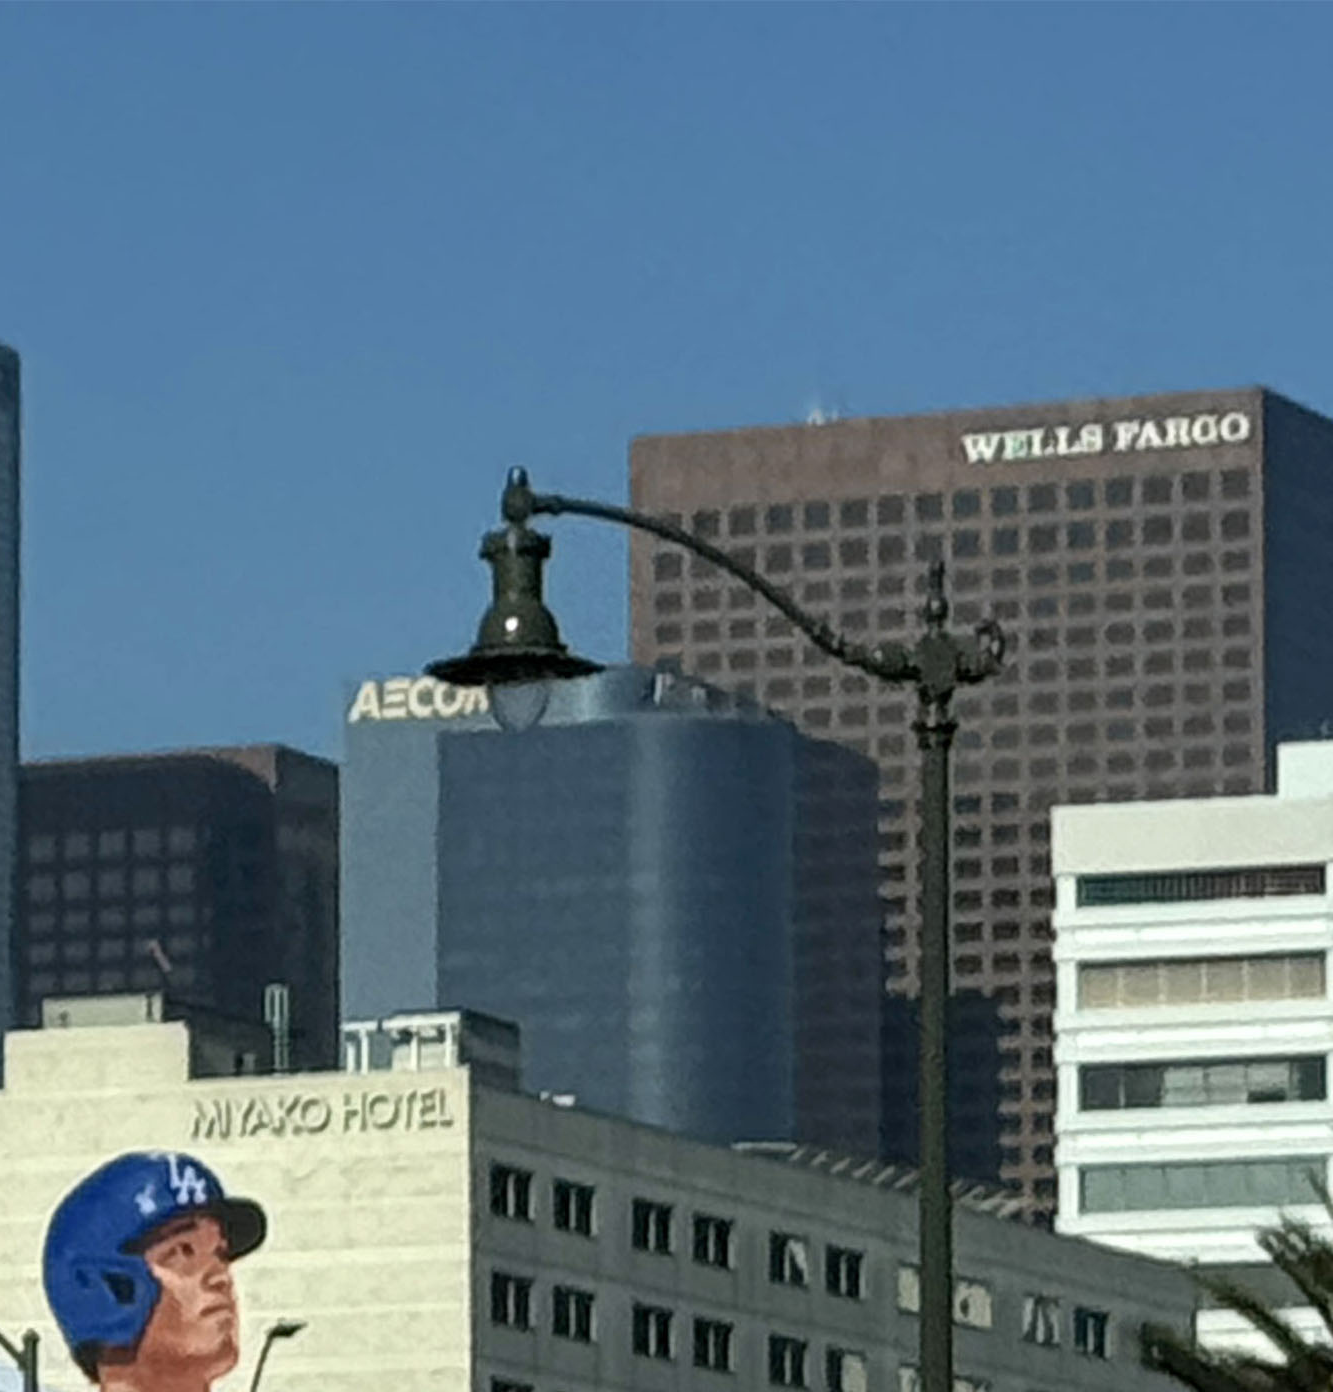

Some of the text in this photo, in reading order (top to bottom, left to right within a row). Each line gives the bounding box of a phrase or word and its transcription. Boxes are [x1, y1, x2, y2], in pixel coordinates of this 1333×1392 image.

[961, 411, 1251, 463] WELLS FARGO
[191, 1086, 454, 1140] MIYAKO HOTEL
